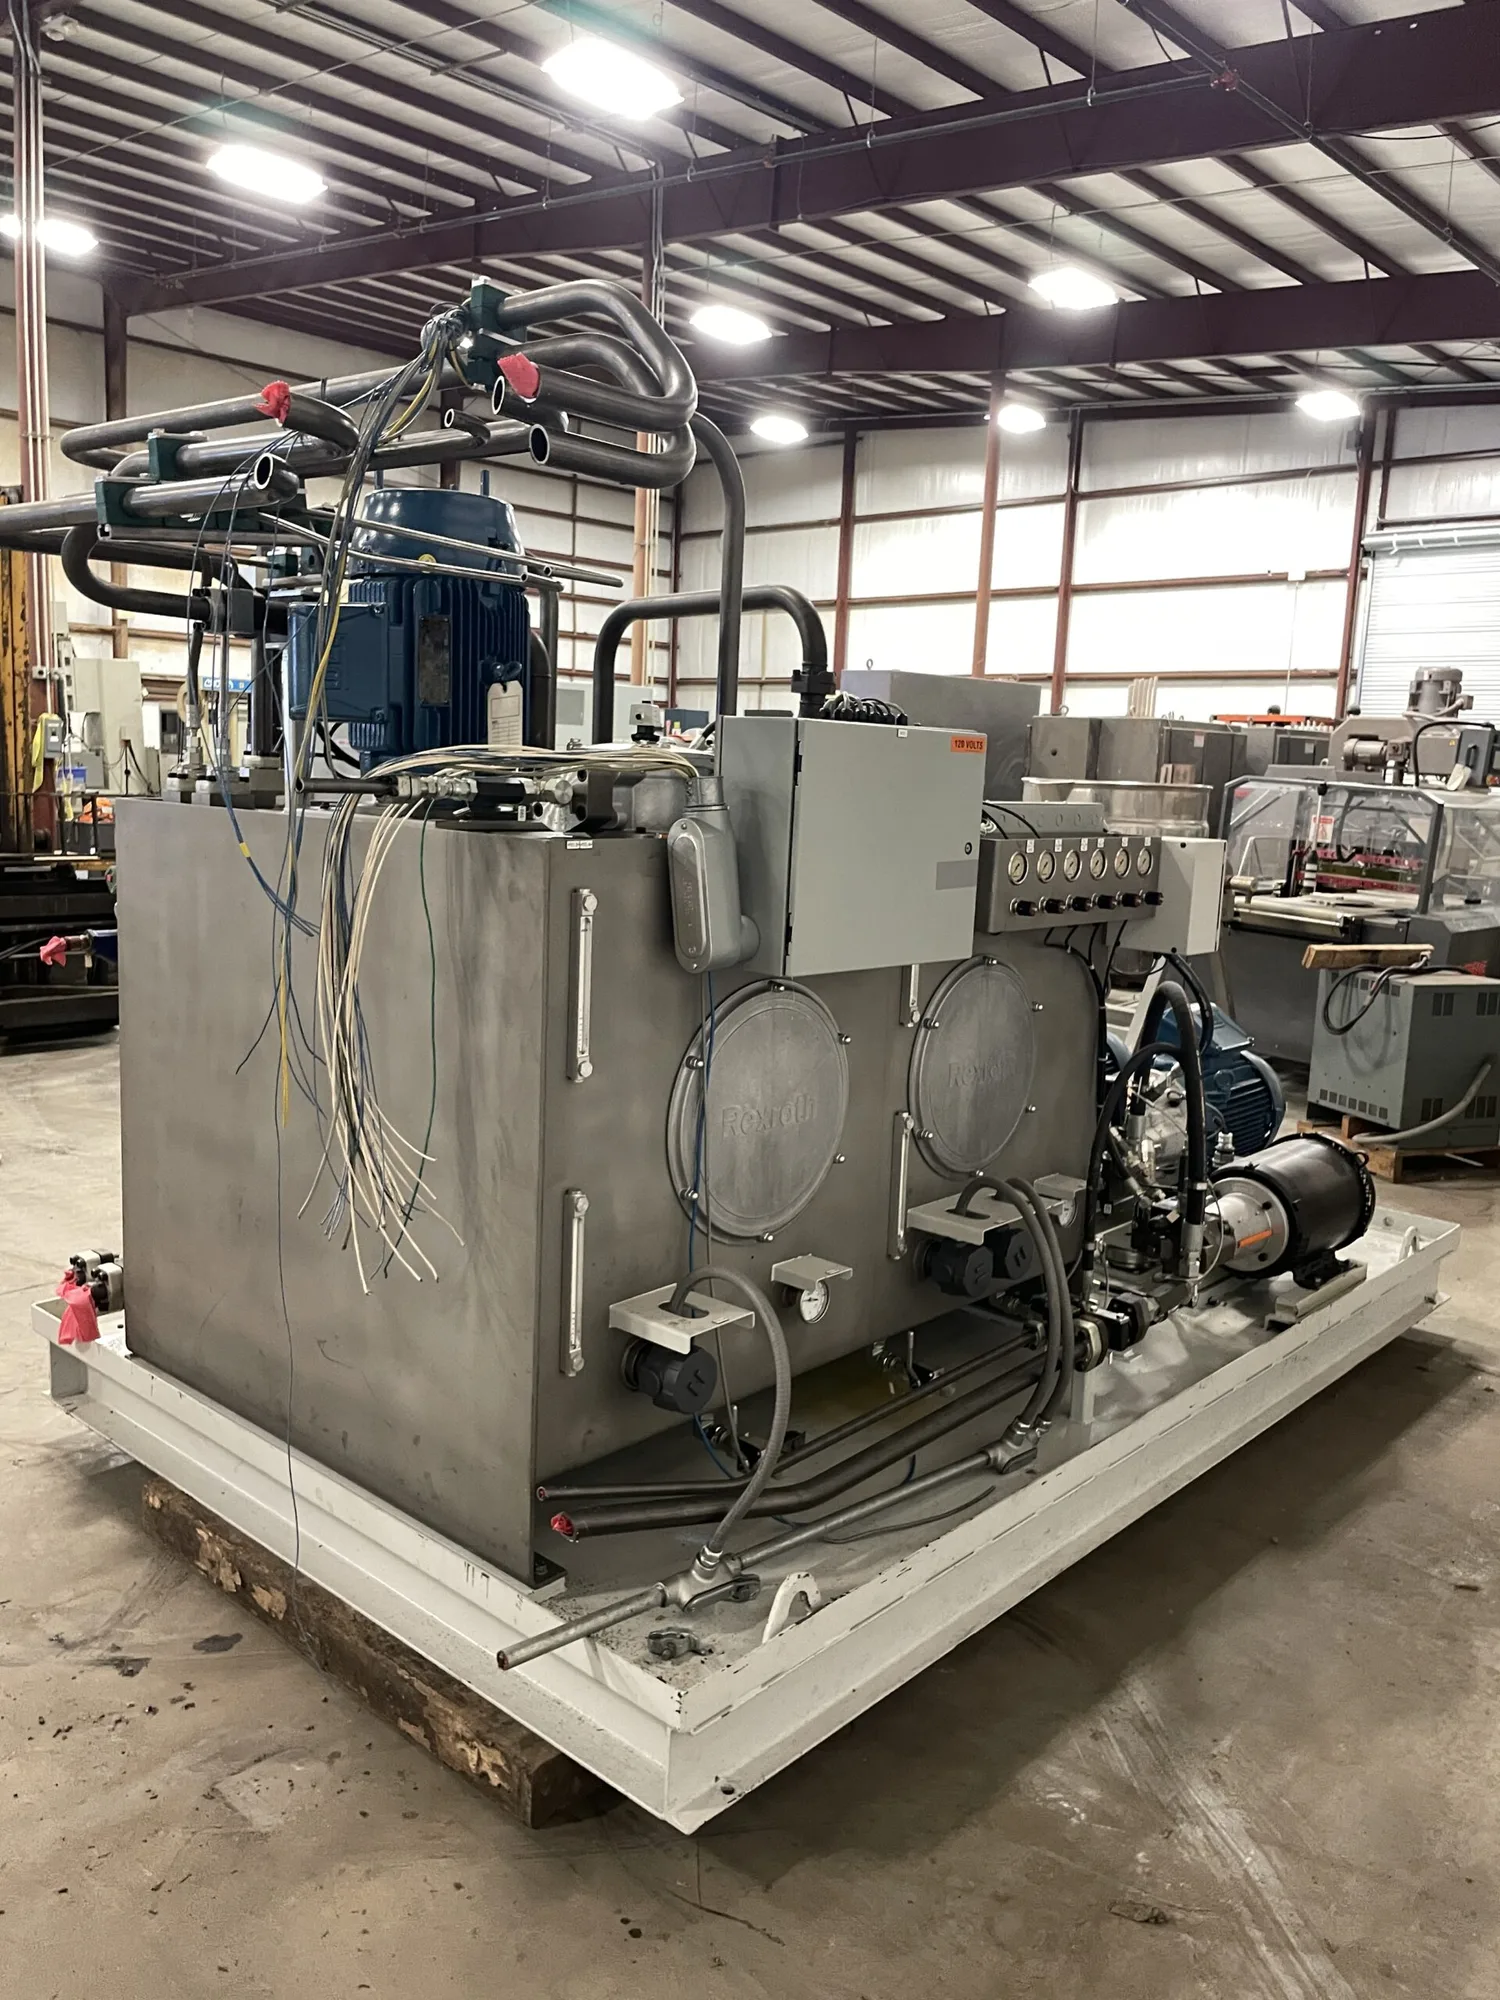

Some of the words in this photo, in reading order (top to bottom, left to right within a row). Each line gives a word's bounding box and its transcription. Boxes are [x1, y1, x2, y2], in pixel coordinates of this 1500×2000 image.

[954, 739, 964, 748] 120
[966, 740, 983, 750] VOLTS
[722, 1094, 818, 1137] Rexroth
